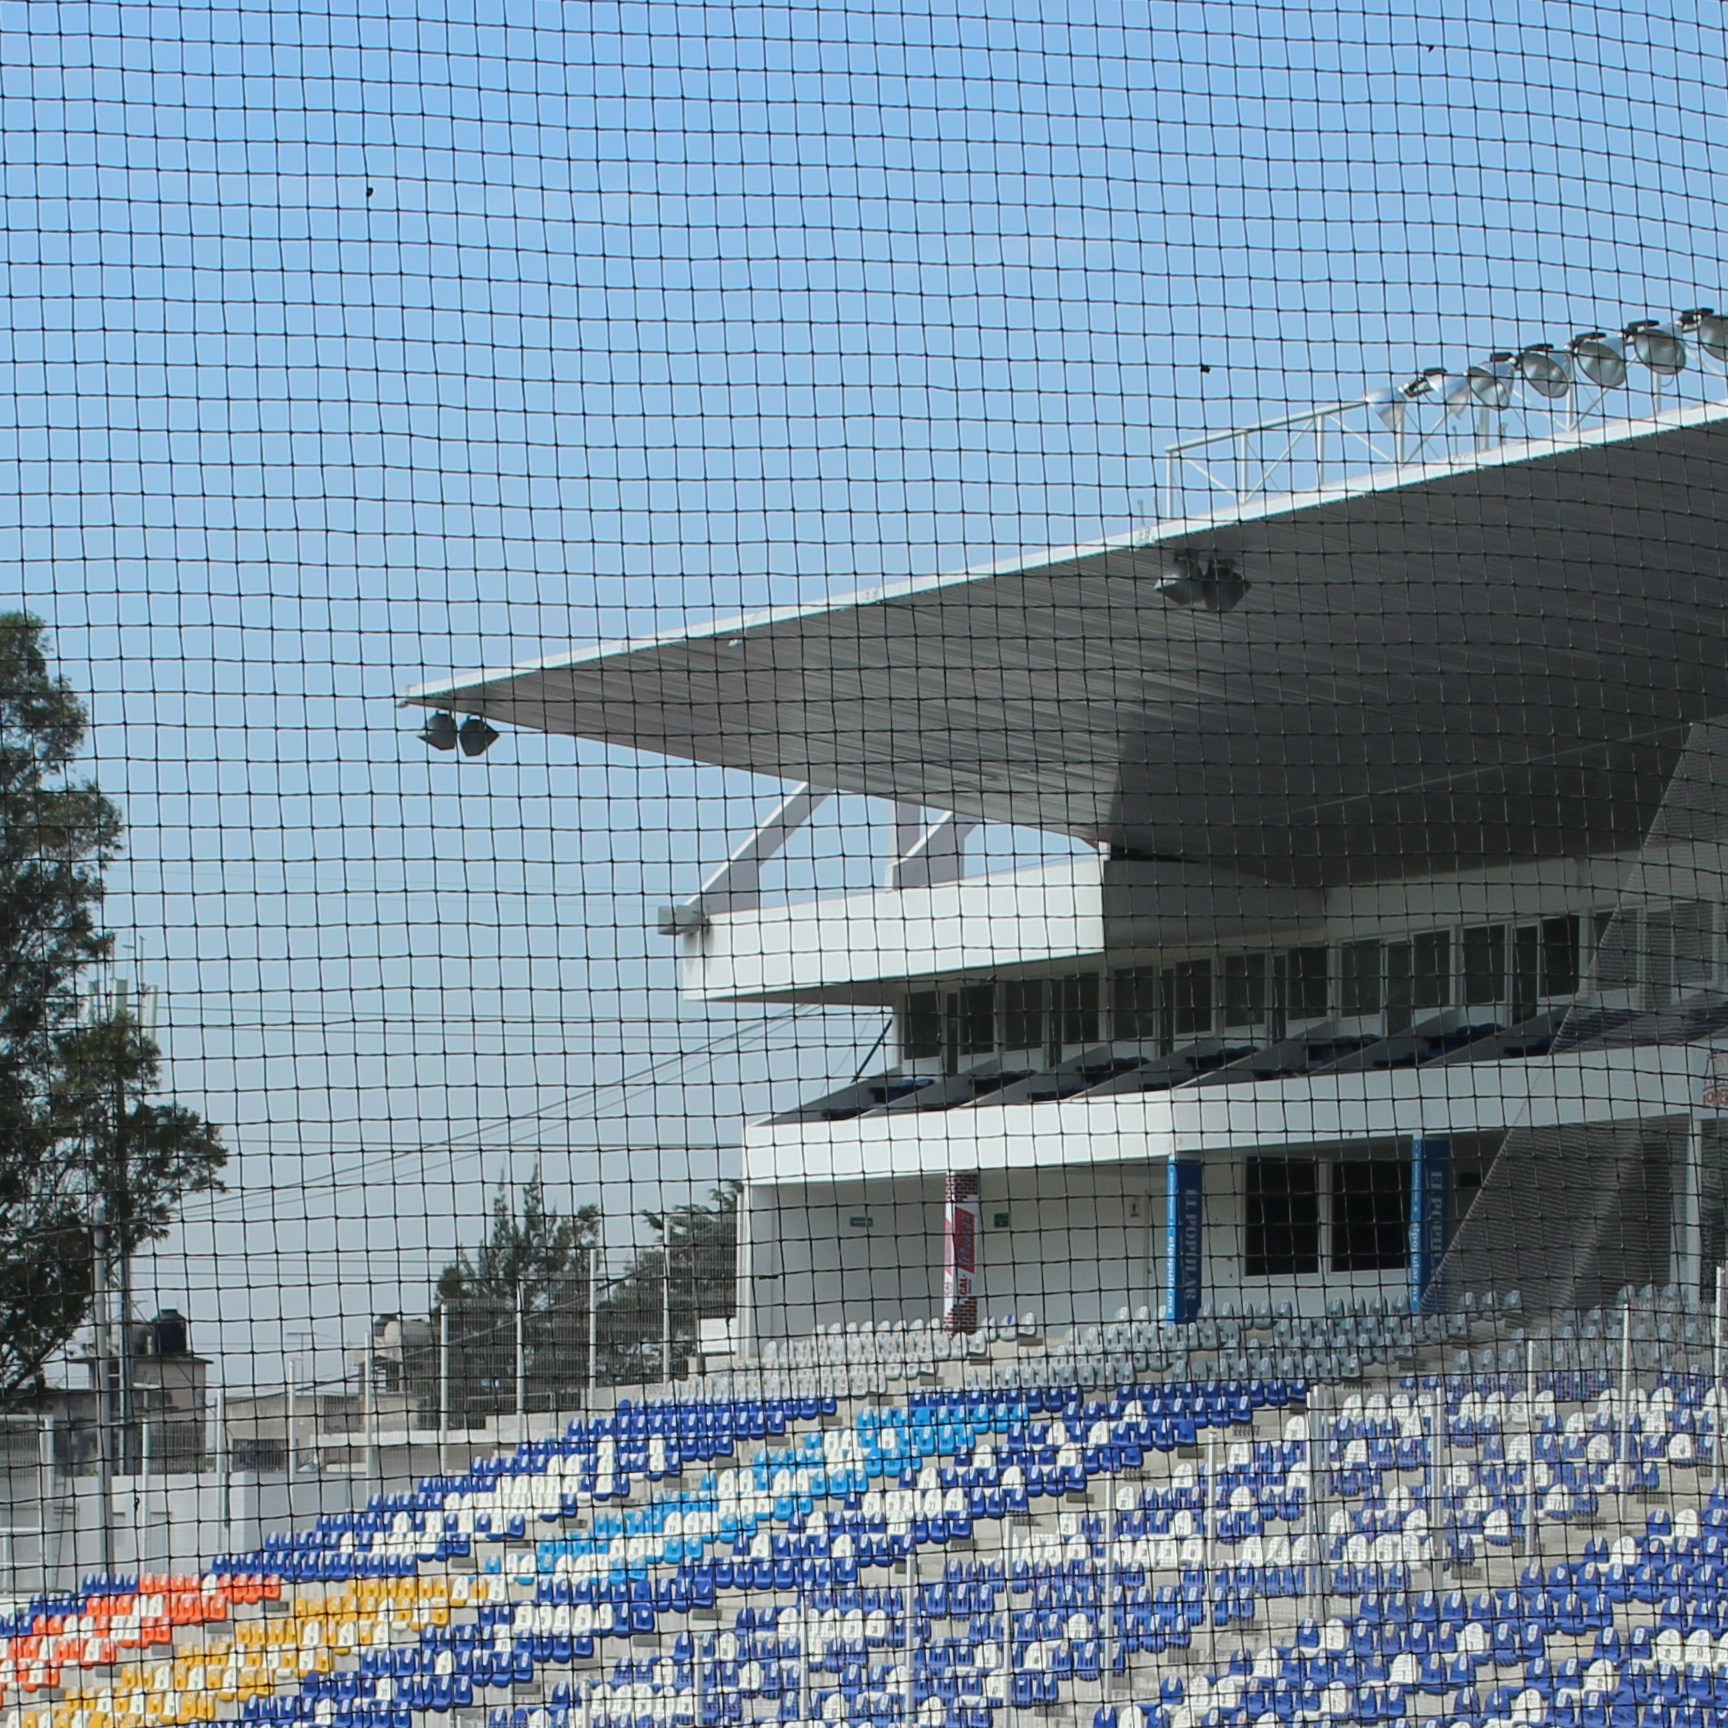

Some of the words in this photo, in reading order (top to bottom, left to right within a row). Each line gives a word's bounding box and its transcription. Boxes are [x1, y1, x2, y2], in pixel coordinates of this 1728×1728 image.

[1184, 1188, 1198, 1211] EL
[1430, 1171, 1444, 1194] EL
[1166, 1235, 1176, 1314] elpopular.mx
[1184, 1213, 1198, 1300] POPULAR
